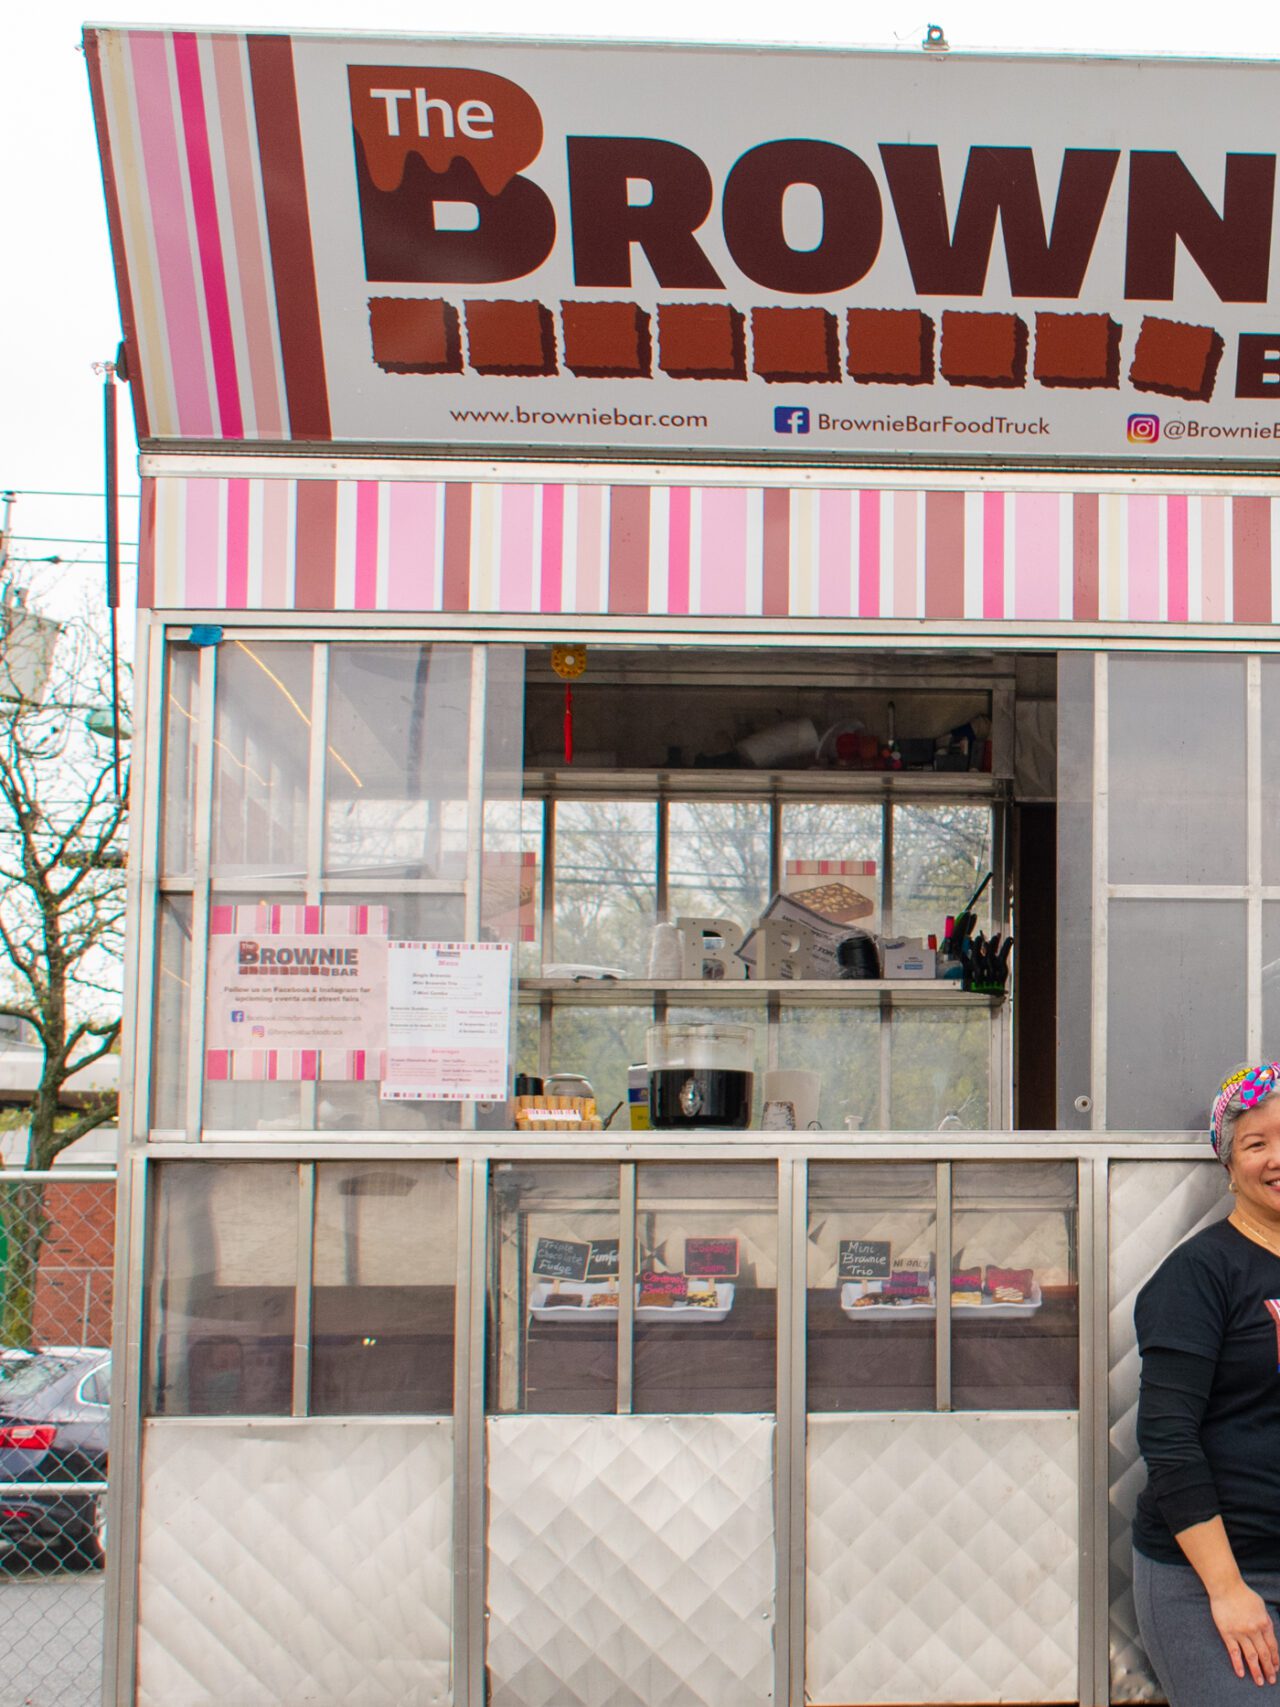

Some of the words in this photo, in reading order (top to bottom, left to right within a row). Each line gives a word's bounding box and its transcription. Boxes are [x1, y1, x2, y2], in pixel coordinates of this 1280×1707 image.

[370, 87, 495, 139] The
[450, 406, 709, 428] www.browniebar.com
[817, 412, 1050, 436] BrownieBarFoodTruck
[238, 940, 359, 965] BROWNIE
[331, 967, 358, 976] BAR
[848, 1241, 875, 1254] Mini
[539, 1258, 573, 1276] Fudge
[841, 1252, 888, 1265] Brownie
[847, 1265, 874, 1277] Trio
